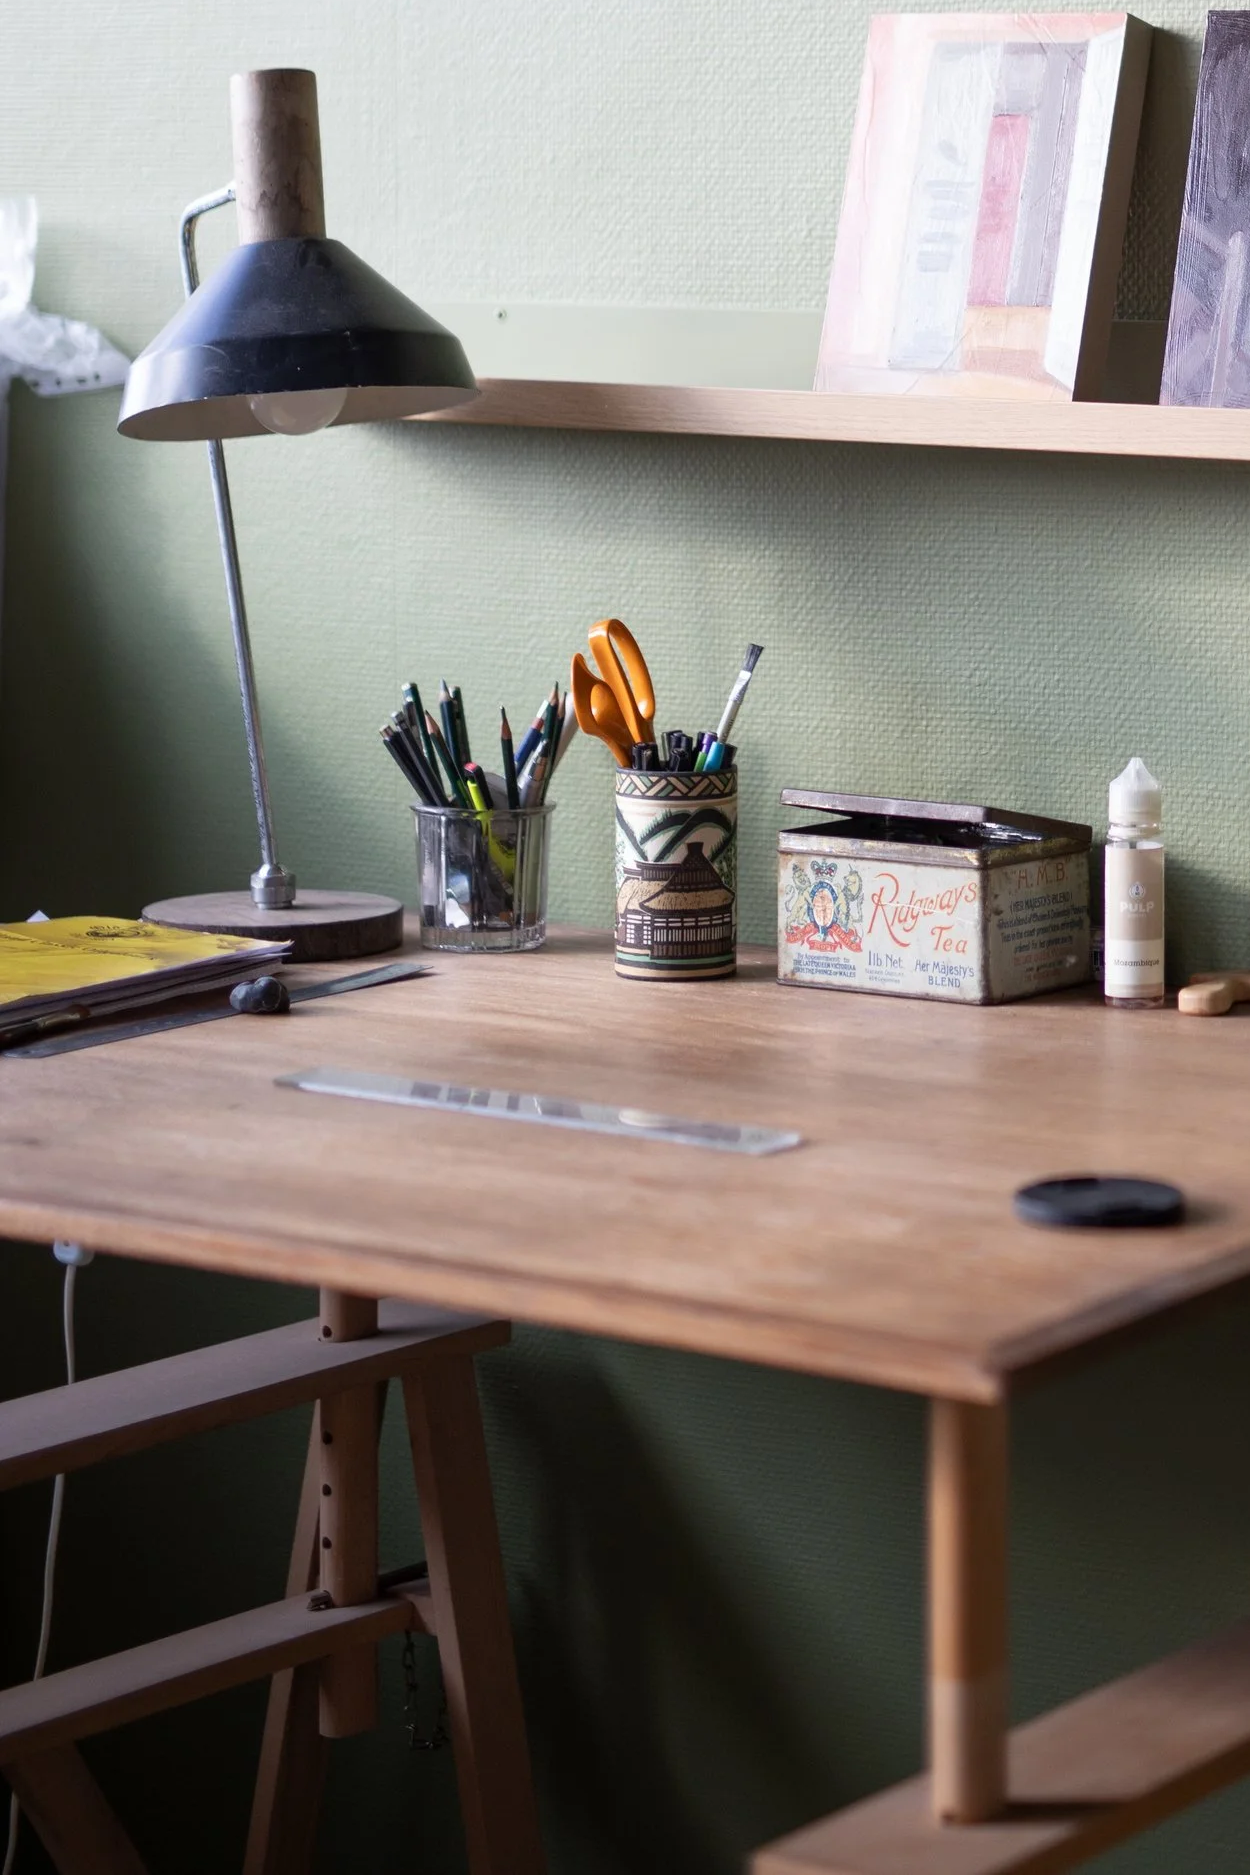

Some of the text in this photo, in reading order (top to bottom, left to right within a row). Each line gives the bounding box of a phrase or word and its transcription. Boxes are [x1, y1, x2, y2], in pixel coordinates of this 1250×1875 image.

[867, 873, 977, 948] Ridgways
[1119, 901, 1155, 913] PULP
[931, 925, 969, 953] Tea
[915, 960, 930, 972] Her
[932, 961, 975, 979] Majesty's
[1114, 959, 1160, 968] Mozambique
[928, 976, 961, 988] BLEND
